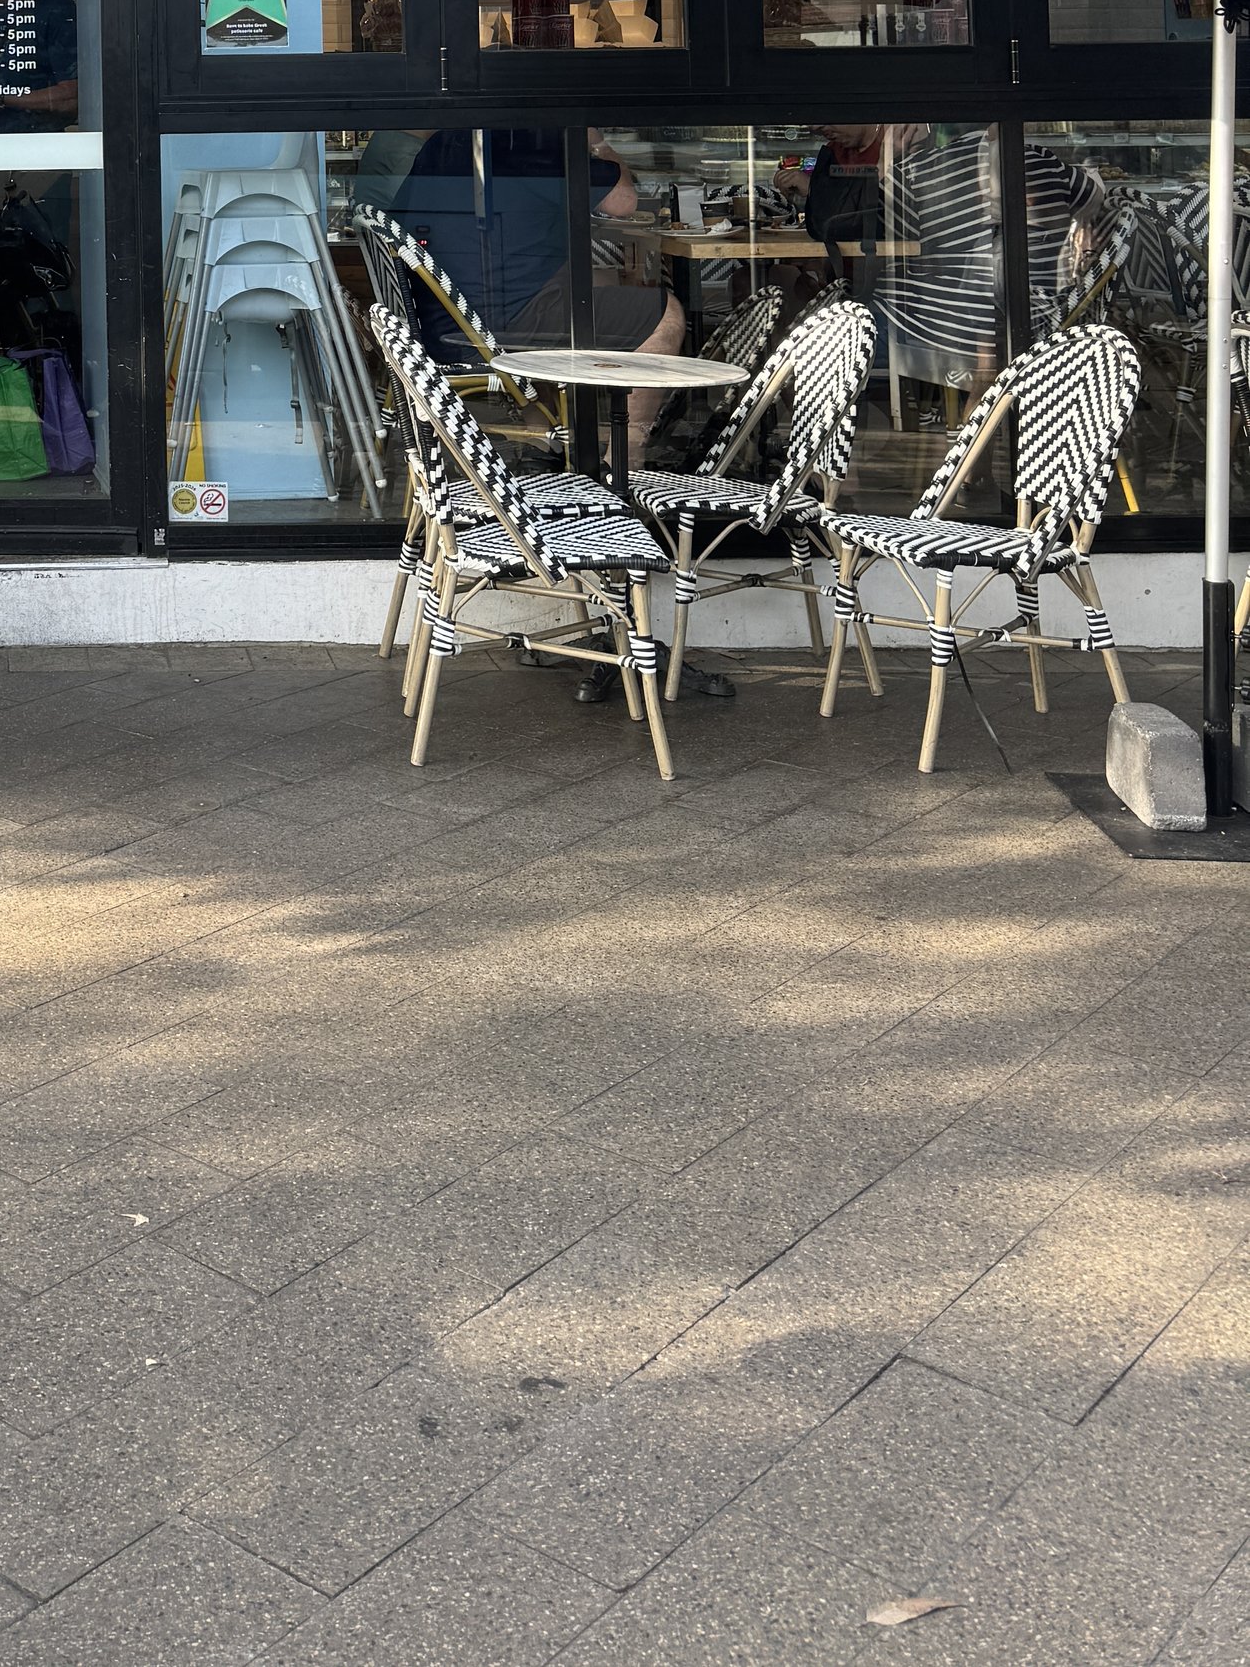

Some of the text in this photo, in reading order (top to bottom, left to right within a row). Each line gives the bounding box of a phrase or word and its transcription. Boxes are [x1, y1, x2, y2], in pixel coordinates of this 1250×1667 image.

[8, 13, 35, 26] 5pm
[8, 29, 36, 42] 5pm
[9, 44, 36, 56] 5pm
[9, 58, 36, 71] 5pm
